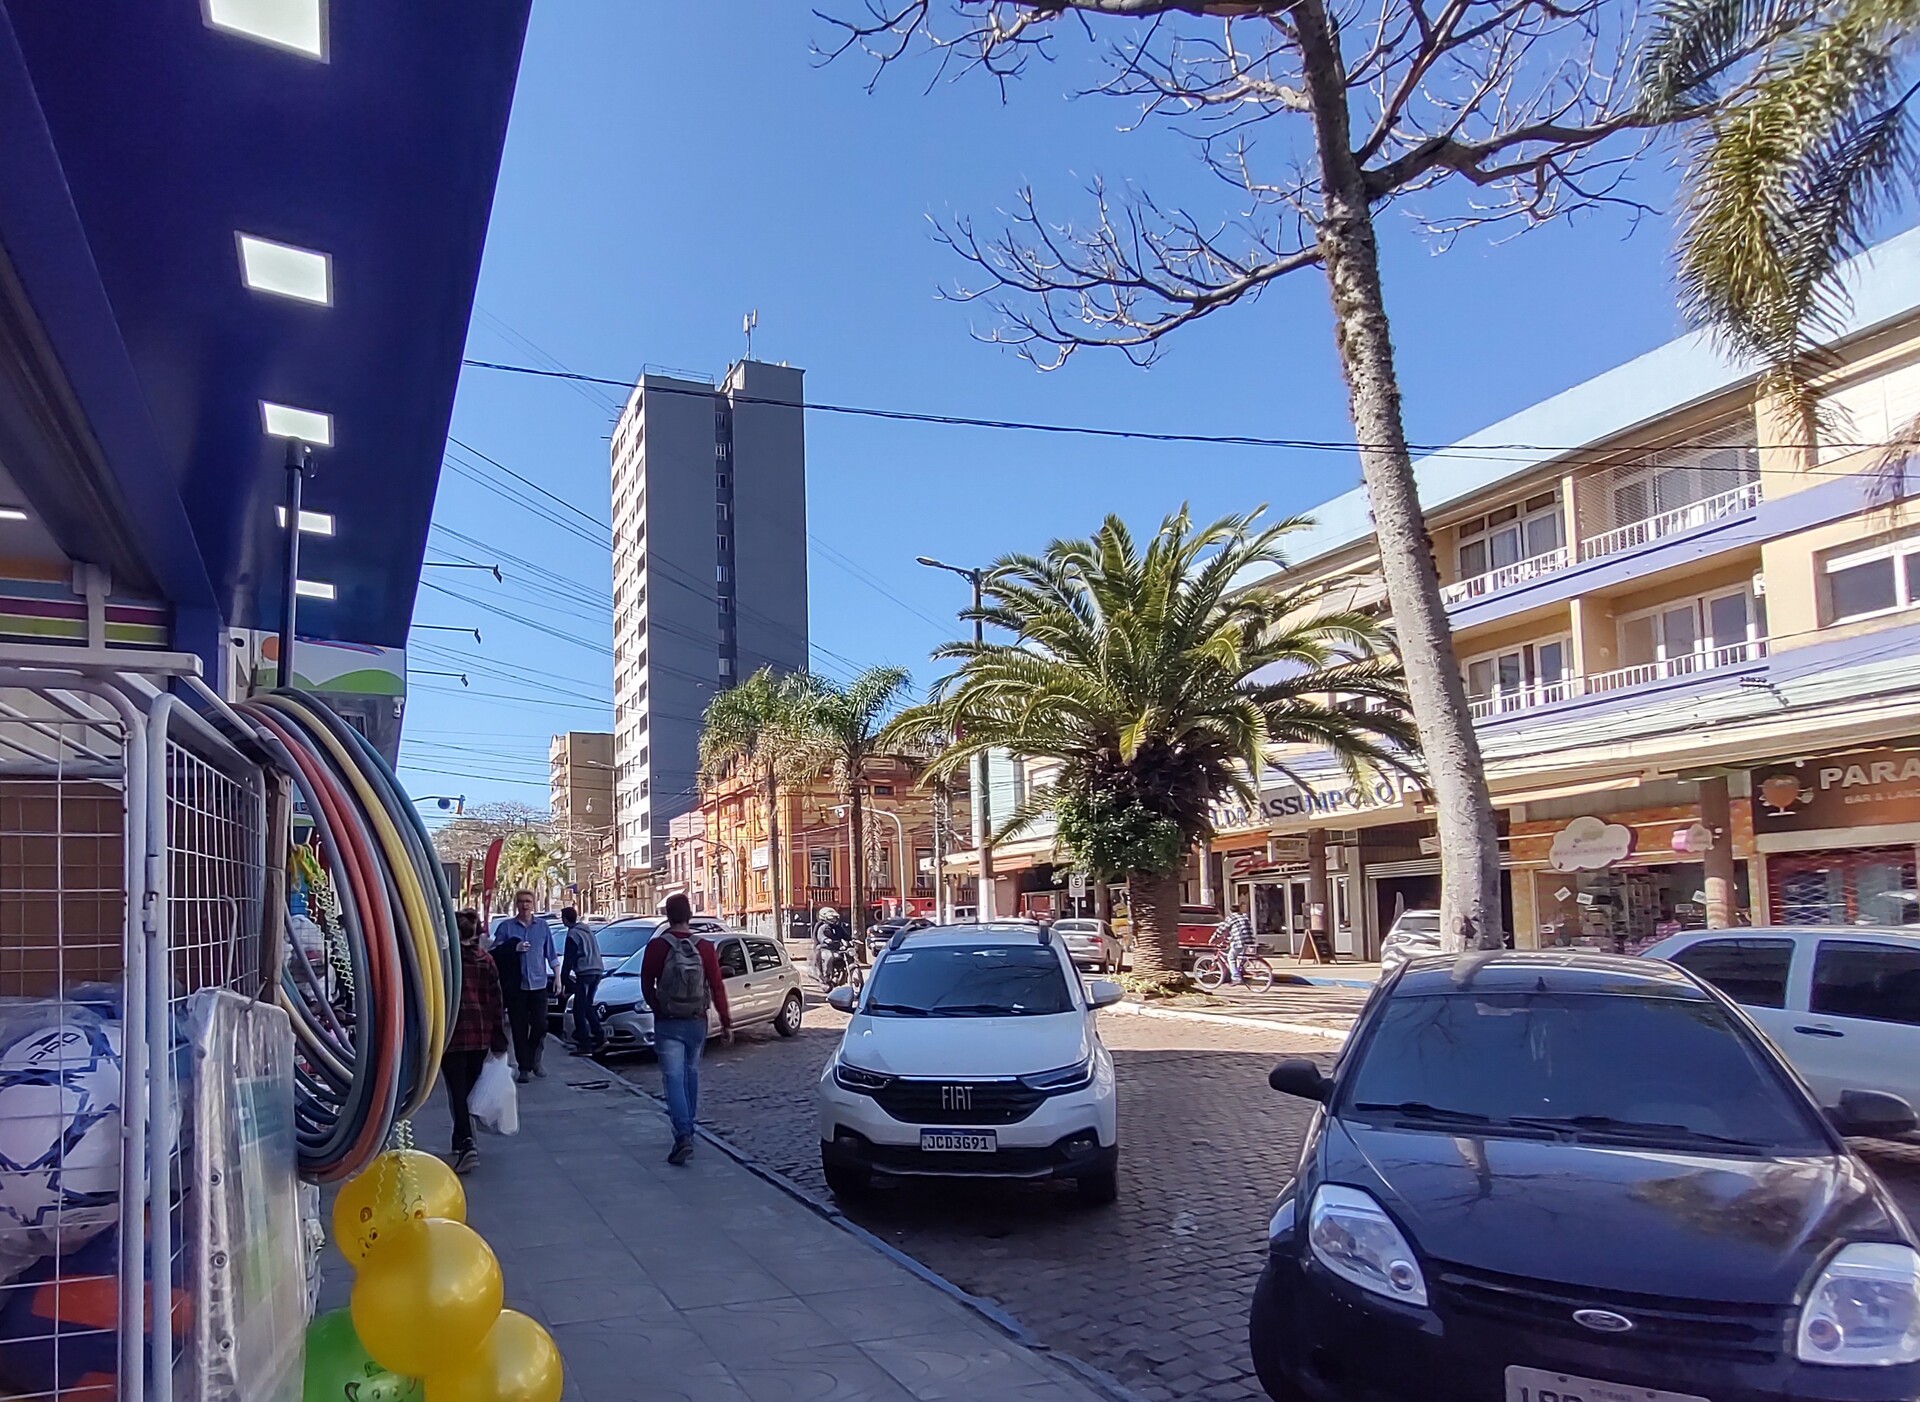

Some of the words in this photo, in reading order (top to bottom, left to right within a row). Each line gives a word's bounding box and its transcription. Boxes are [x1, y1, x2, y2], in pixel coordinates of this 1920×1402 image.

[1819, 757, 1920, 790] PARA
[1844, 793, 1871, 804] BAR
[941, 1085, 974, 1111] FIAT
[927, 1135, 989, 1150] JCD3G91
